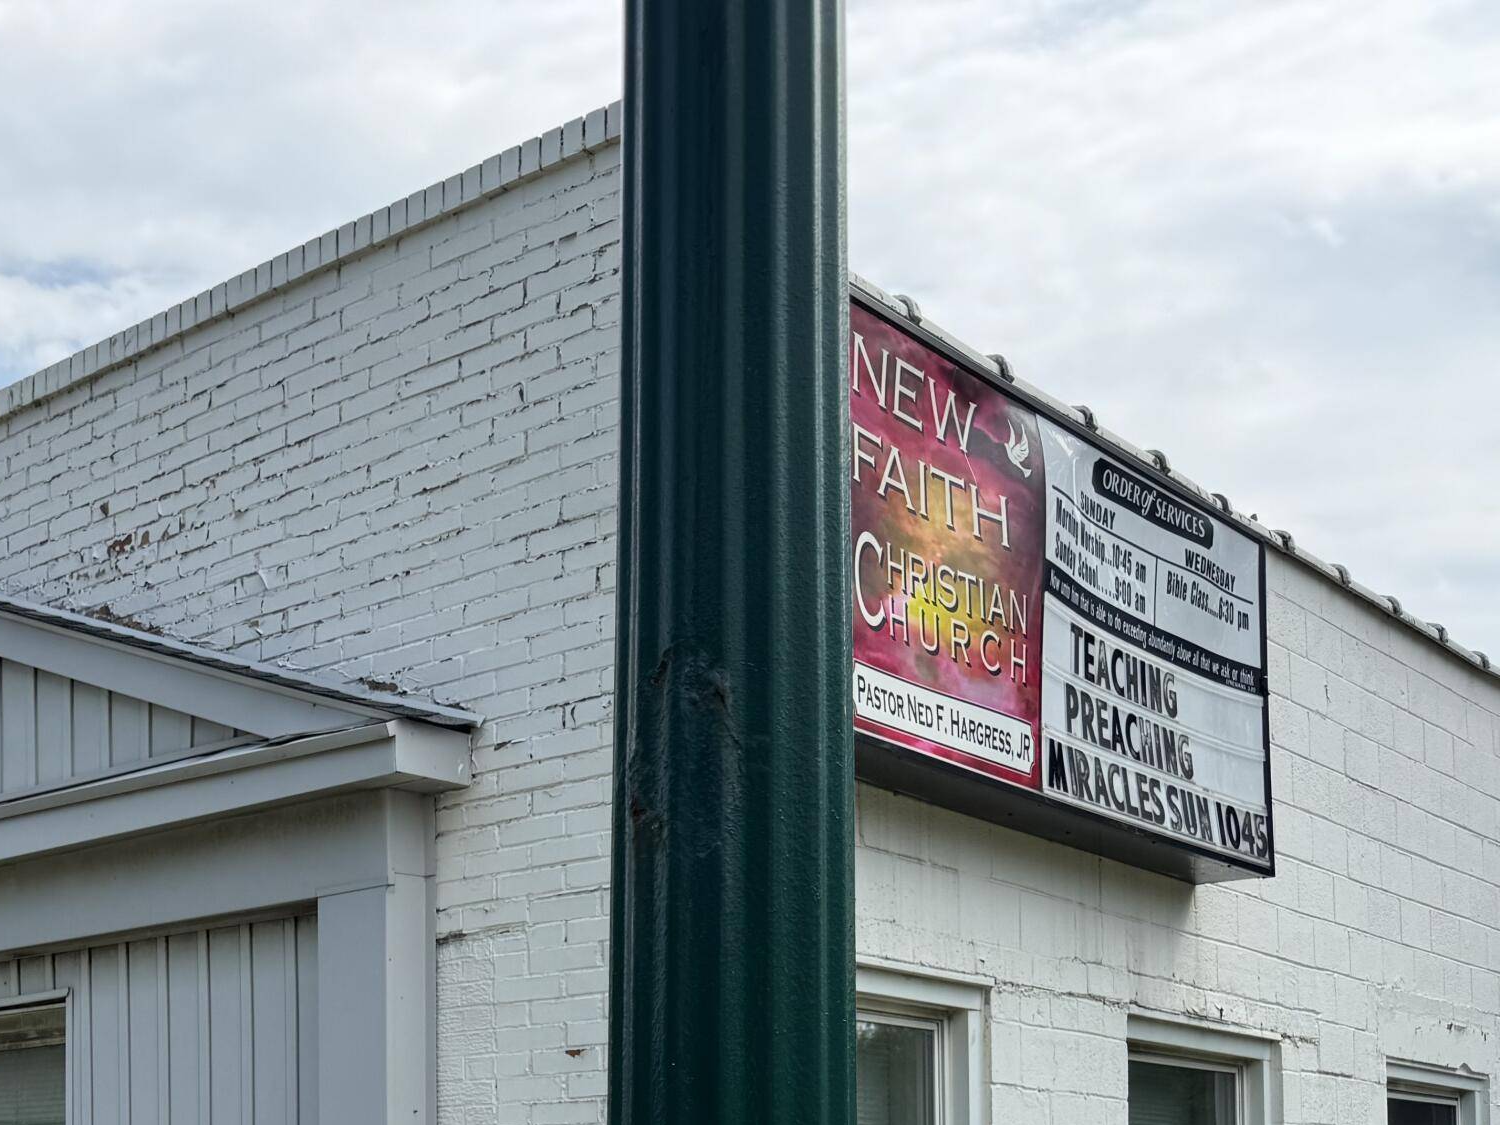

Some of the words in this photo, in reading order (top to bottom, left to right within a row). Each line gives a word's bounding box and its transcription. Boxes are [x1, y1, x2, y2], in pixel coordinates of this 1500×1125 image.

[852, 330, 979, 454] NEW
[852, 422, 1010, 549] FAITH
[1080, 490, 1116, 530] SUNDAY
[1102, 468, 1140, 507] ORDER
[1141, 489, 1157, 517] of
[1155, 497, 1206, 539] SERVICES
[1055, 531, 1077, 577] Sunday
[1134, 592, 1146, 615] am
[1056, 496, 1079, 546] Morning
[1135, 560, 1146, 584] am
[1184, 548, 1236, 592] WEDNESDAY
[854, 531, 1028, 638] CHRISTIAN
[1166, 570, 1188, 602] Bible
[1237, 610, 1250, 632] pm
[1069, 622, 1178, 719] TEACHING
[1095, 603, 1106, 623] able
[1107, 611, 1114, 627] to
[1114, 613, 1122, 631] do
[1122, 620, 1147, 649] exceeding
[1148, 630, 1176, 661] abundantly
[1176, 643, 1192, 664] above
[1192, 650, 1200, 668] all
[1200, 652, 1211, 672] that
[1211, 661, 1220, 675] we
[1220, 662, 1231, 679] ask
[1231, 669, 1238, 681] or
[1240, 668, 1255, 686] think
[857, 674, 904, 721] PASTOR
[936, 704, 948, 735] F.
[950, 708, 1014, 761] HARGRESS,
[1016, 732, 1031, 762] JR
[1064, 682, 1194, 780] PREACHING
[1048, 737, 1166, 826] MIRACLES
[1166, 784, 1216, 843] SUN
[1215, 801, 1268, 858] 1045
